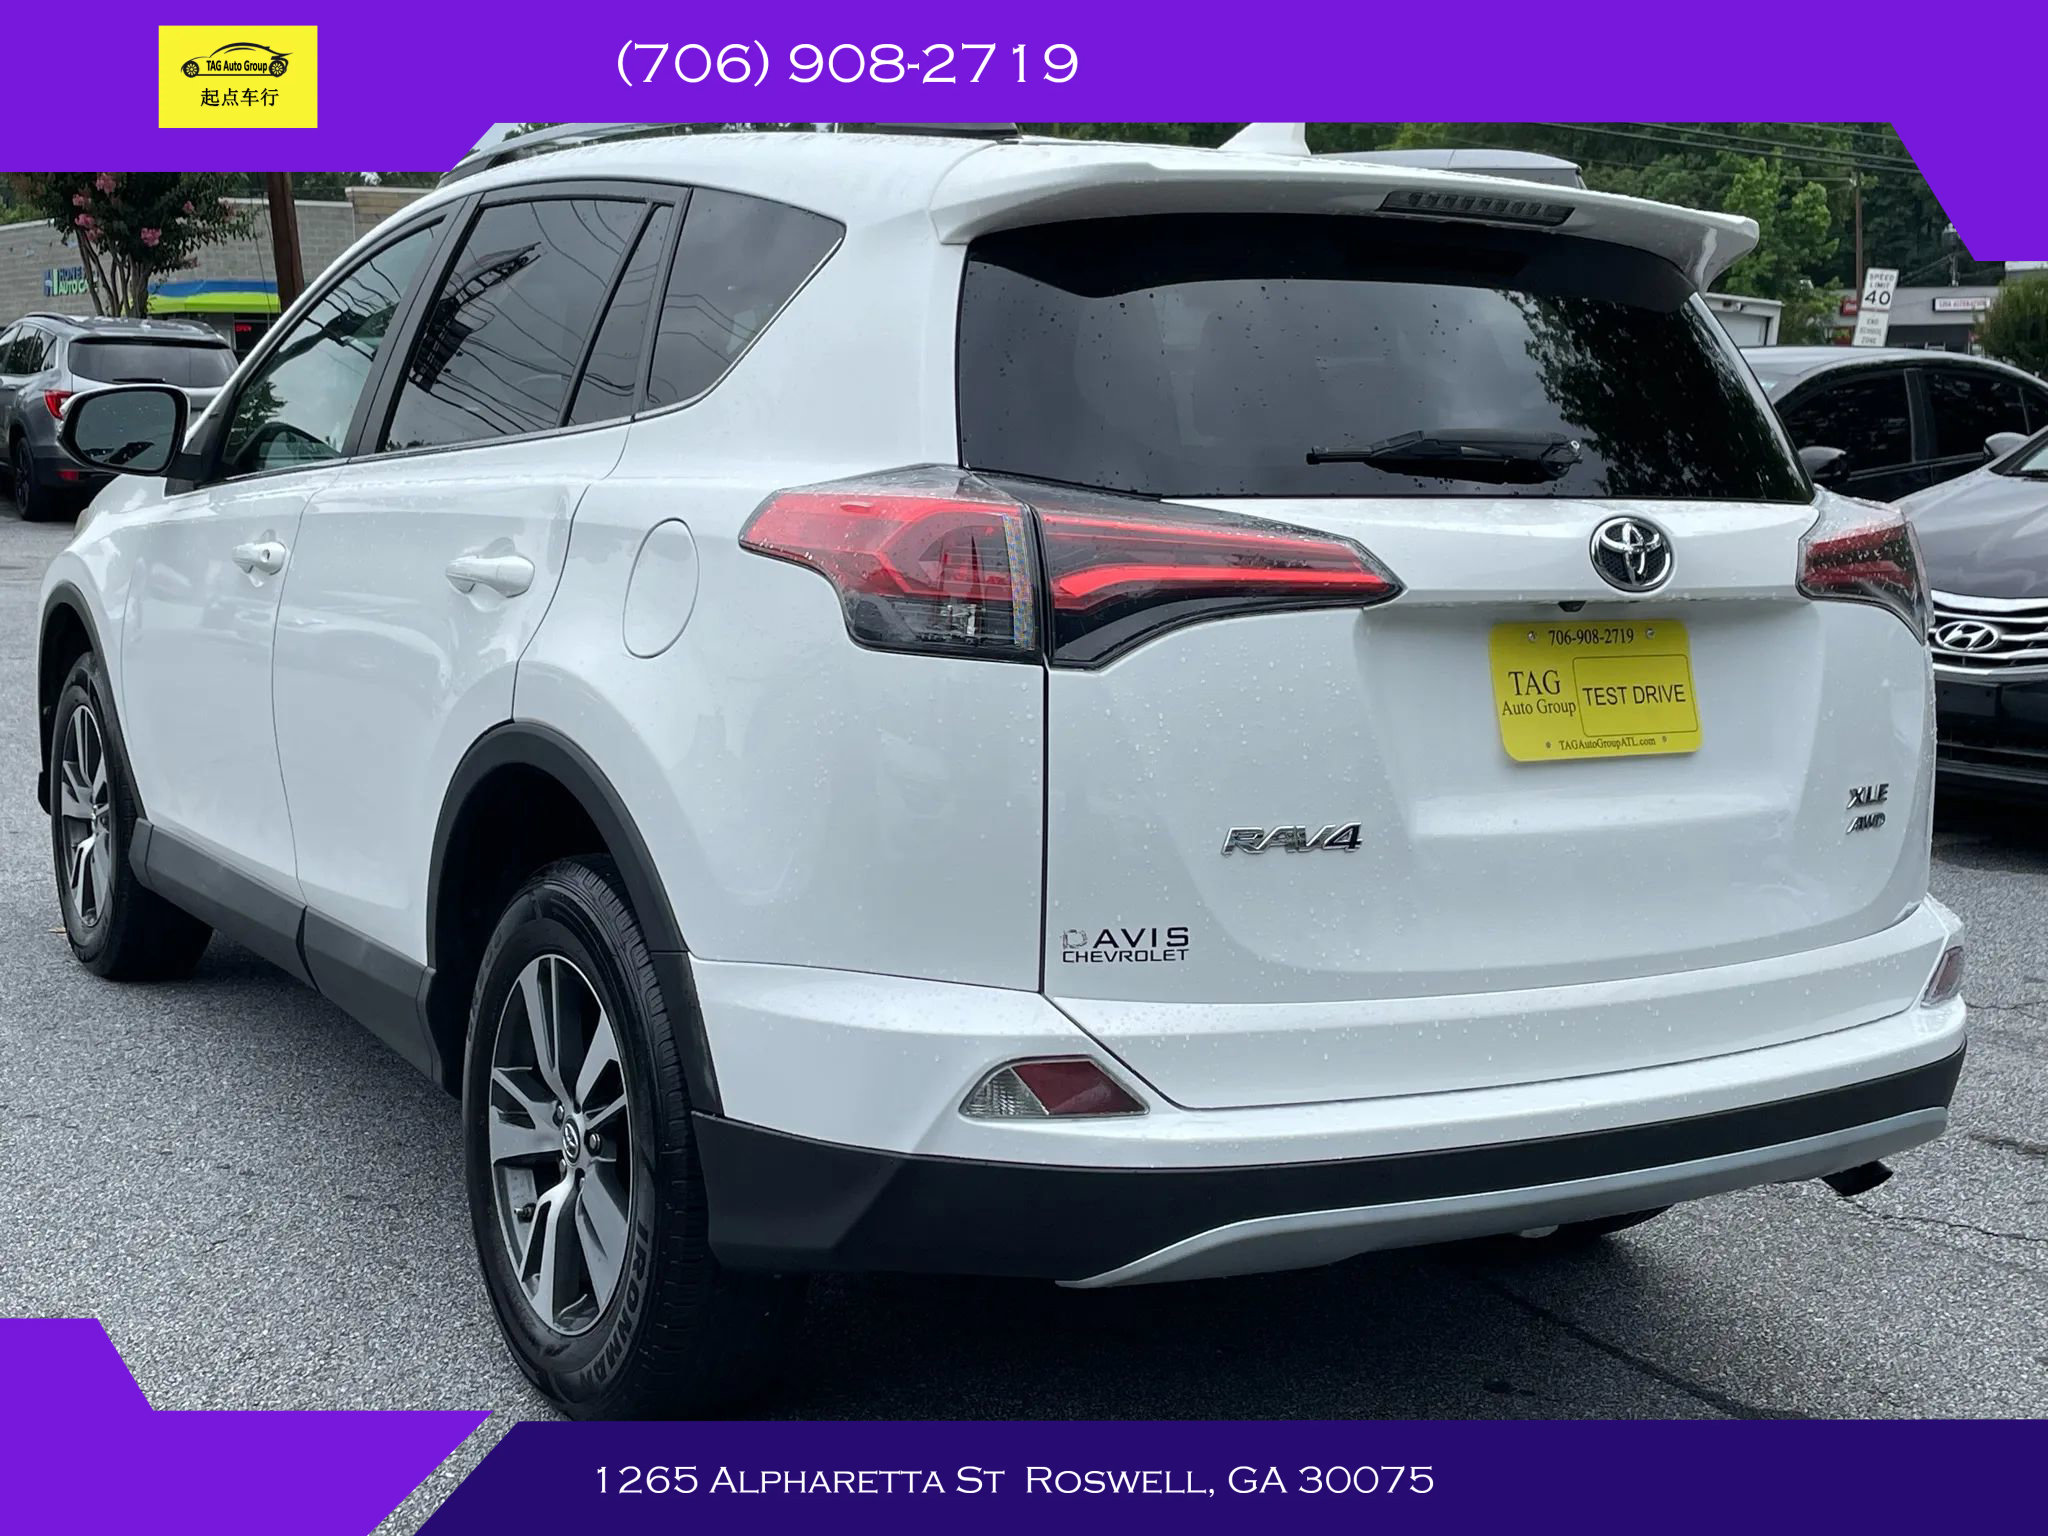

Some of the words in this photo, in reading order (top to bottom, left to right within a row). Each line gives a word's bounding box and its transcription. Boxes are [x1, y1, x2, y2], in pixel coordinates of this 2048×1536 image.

[60, 266, 91, 281] HONE
[1870, 273, 1895, 281] SPEED
[59, 280, 78, 295] AUTO
[1864, 290, 1891, 305] 40
[1548, 628, 1635, 646] 706-908-2719
[1508, 669, 1561, 696] TAG
[1582, 686, 1628, 706] TEST
[1633, 684, 1686, 704] DRIVE
[1502, 700, 1533, 716] Auto
[1536, 698, 1577, 718] Group
[1558, 737, 1656, 751] TAGAutoGroupATL.com
[1847, 783, 1889, 809] XLE
[1846, 812, 1886, 835] AWD
[1220, 821, 1363, 856] RAV4
[1062, 948, 1189, 963] CHEVROLET
[579, 1219, 649, 1385] IRONMAN
